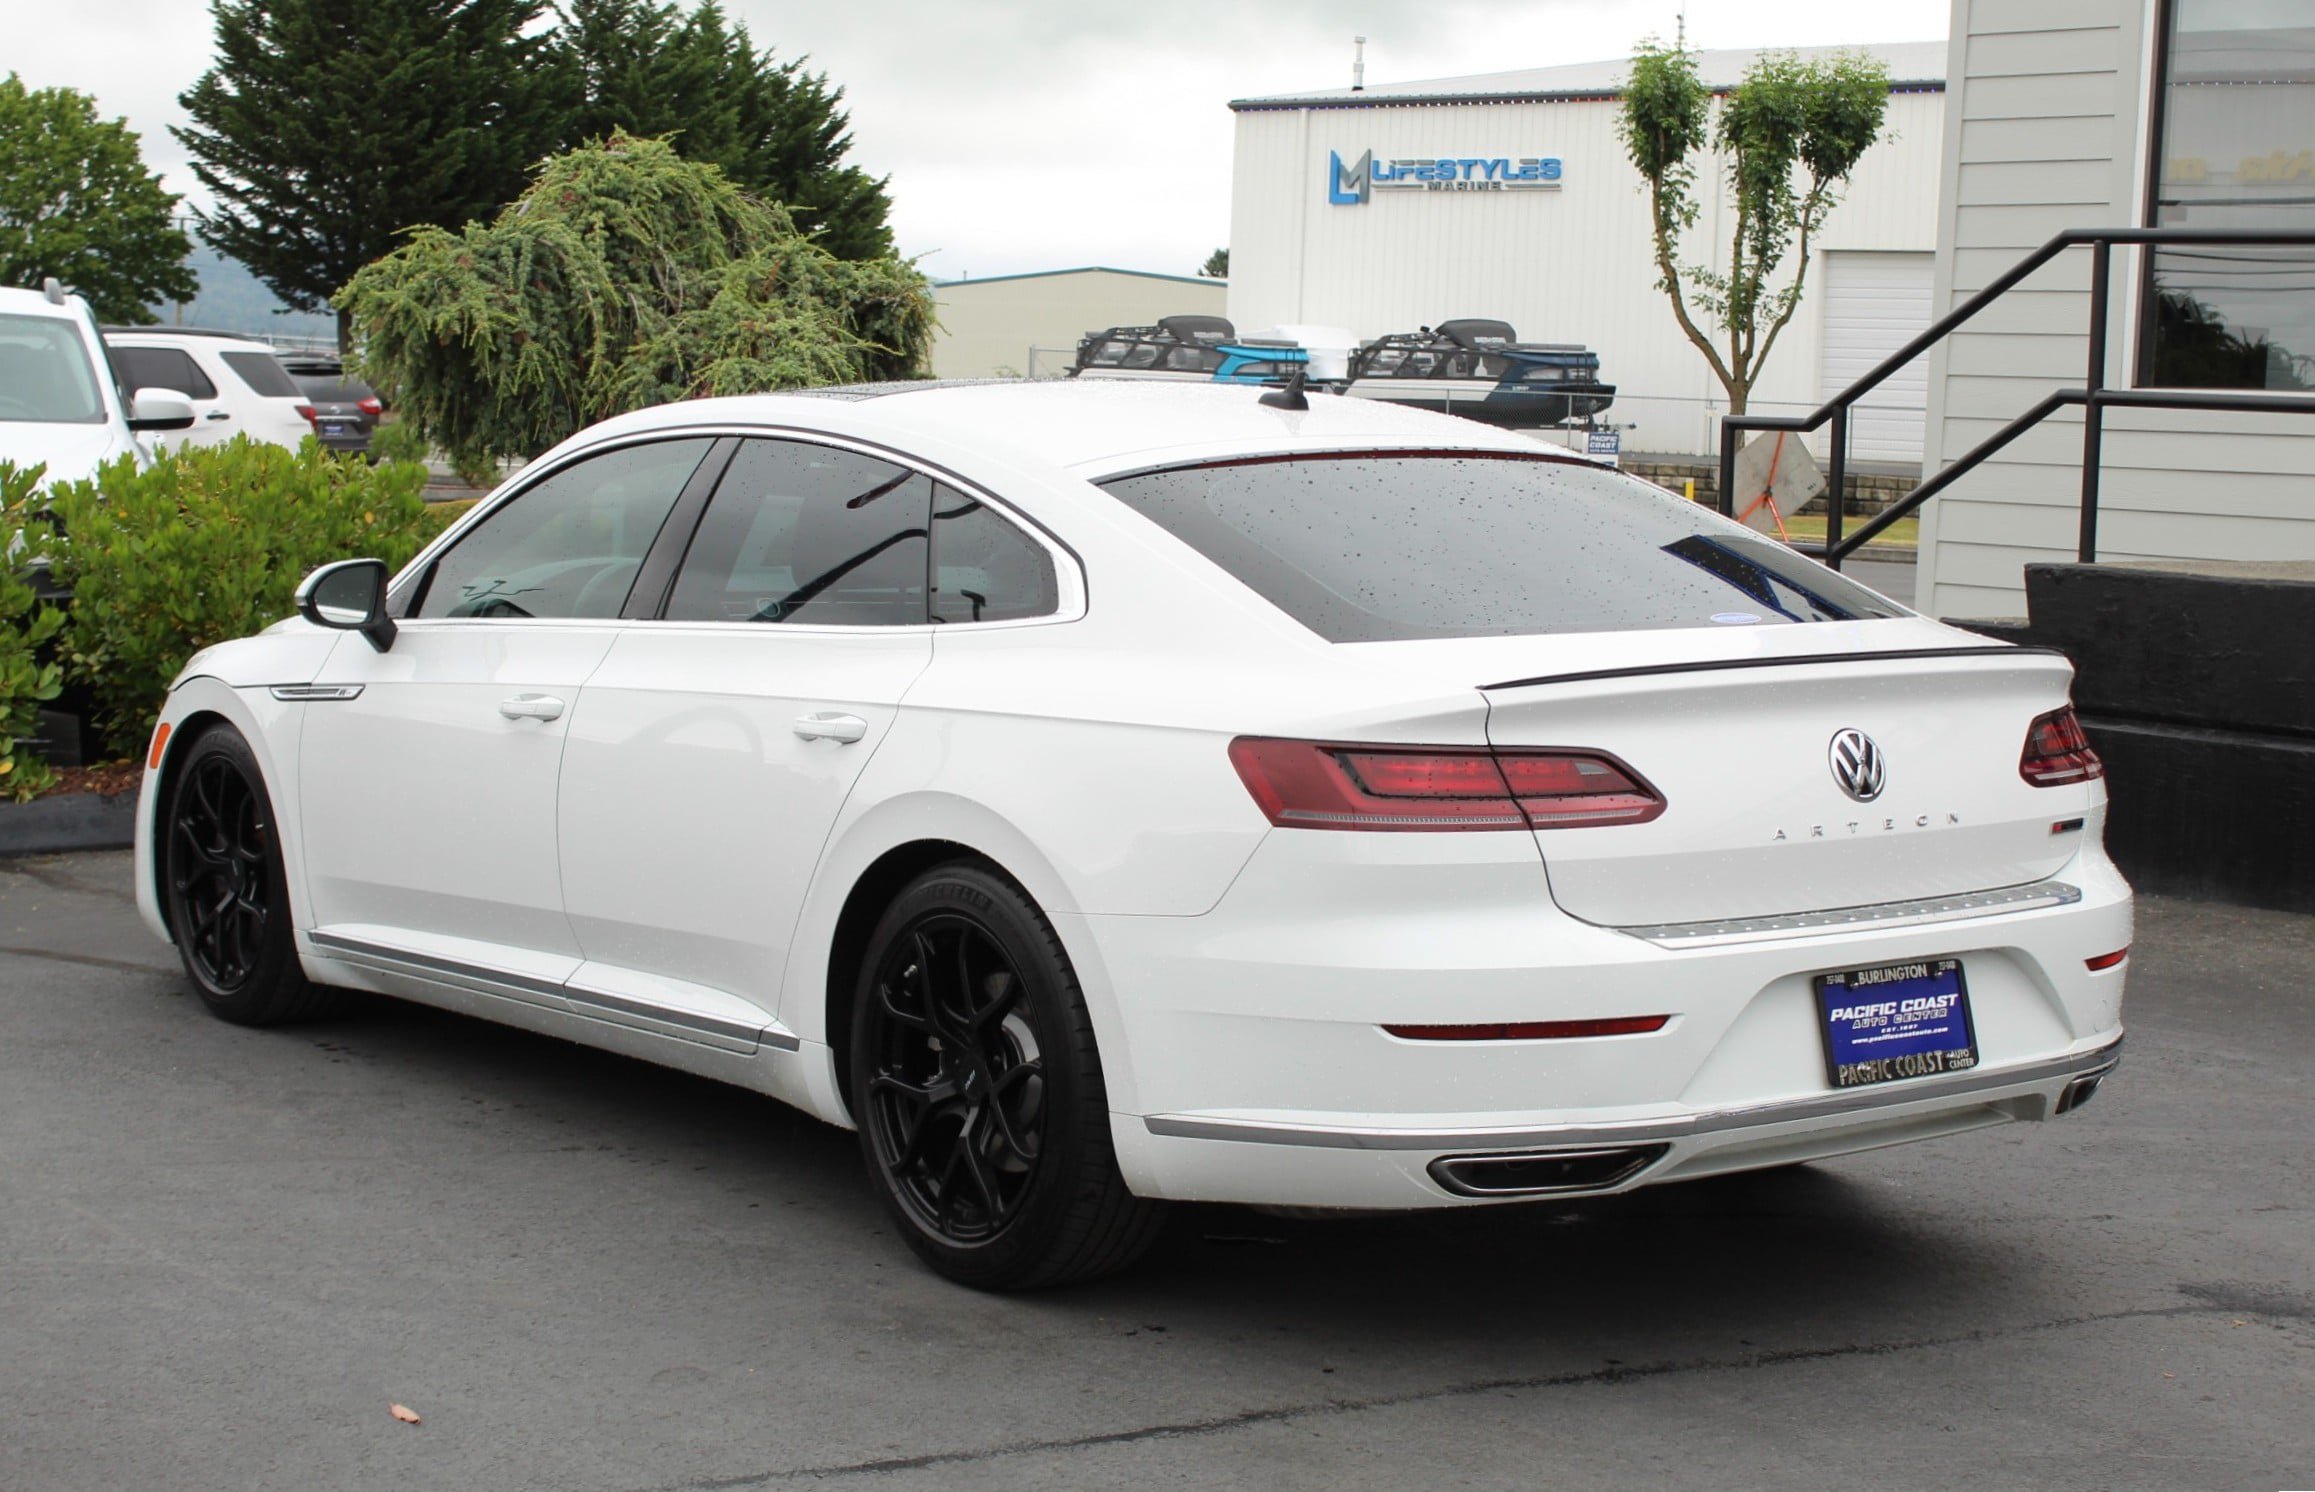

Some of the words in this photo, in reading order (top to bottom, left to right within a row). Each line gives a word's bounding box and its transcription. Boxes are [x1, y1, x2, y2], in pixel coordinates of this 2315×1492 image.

[1426, 180, 1502, 192] MARINE
[1590, 435, 1617, 443] PACIFIC
[1772, 811, 1960, 841] ARTEON
[1858, 963, 1928, 986] BURLINGTON
[1830, 1001, 1897, 1022] PACIFIC
[1900, 993, 1959, 1013] COAST
[1852, 1016, 1888, 1030] AUTO
[1893, 1007, 1948, 1025] CENTER
[1947, 1048, 1970, 1059] AUTO
[1948, 1057, 1975, 1070] CENTER
[1838, 1058, 1893, 1086] PACIFIC
[1895, 1049, 1944, 1077] COAST
